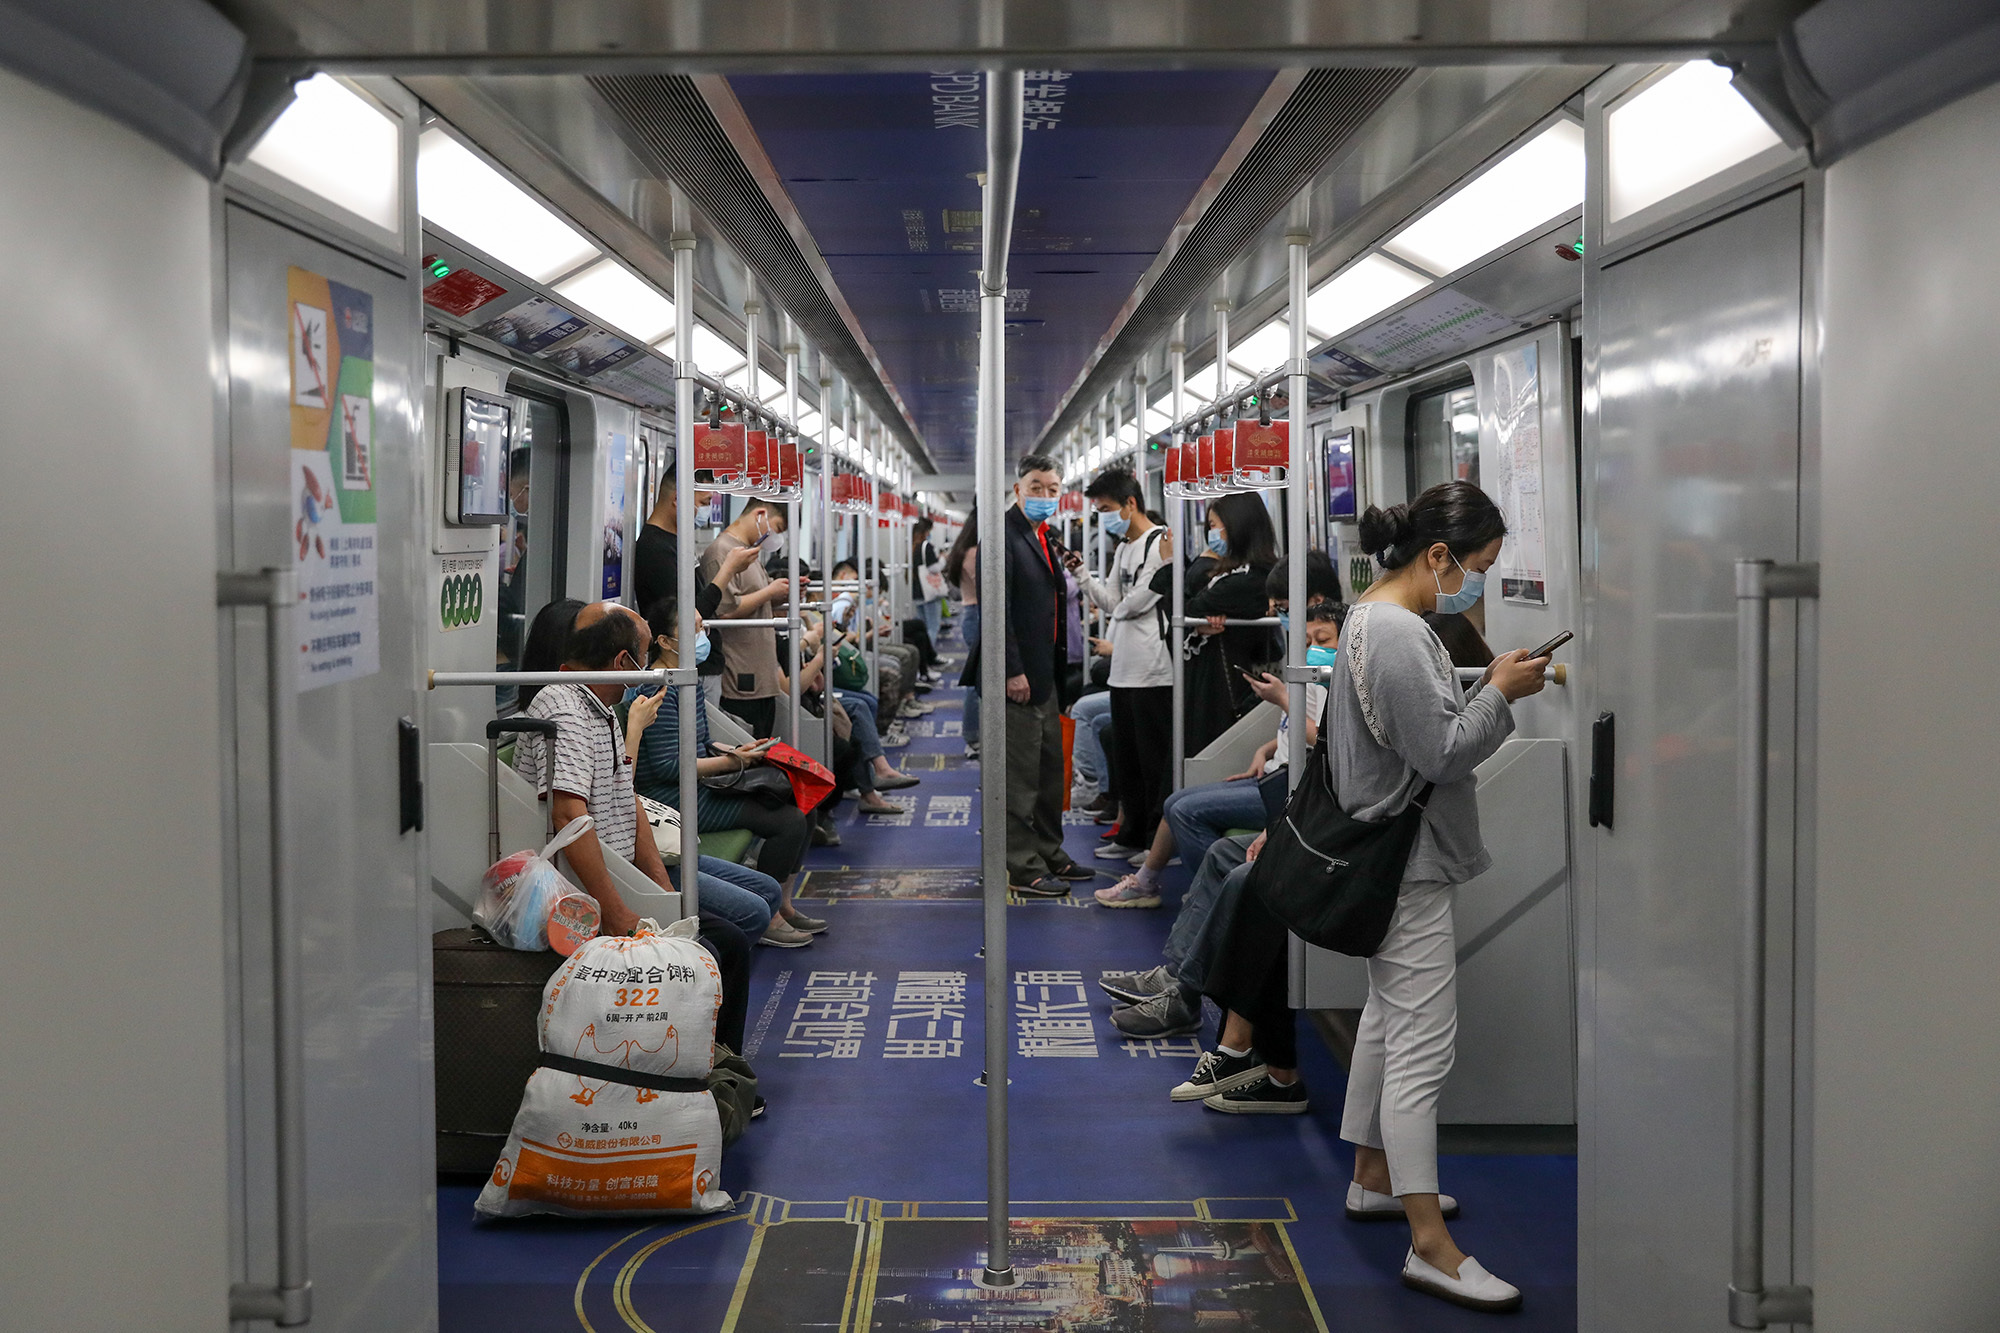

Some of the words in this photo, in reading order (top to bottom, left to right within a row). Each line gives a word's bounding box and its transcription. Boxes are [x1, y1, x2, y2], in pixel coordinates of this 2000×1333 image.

[931, 95, 980, 129] BANK
[574, 963, 696, 984] 蛋中鸡配合饲料
[614, 987, 660, 1007] 322
[778, 970, 878, 1059] 走向全世界
[882, 970, 968, 1059] 根植长三角
[1013, 969, 1099, 1058] 根植长三角
[617, 1120, 638, 1130] 40kg
[546, 1173, 600, 1192] 科技力量
[605, 1174, 659, 1191] 创富保障
